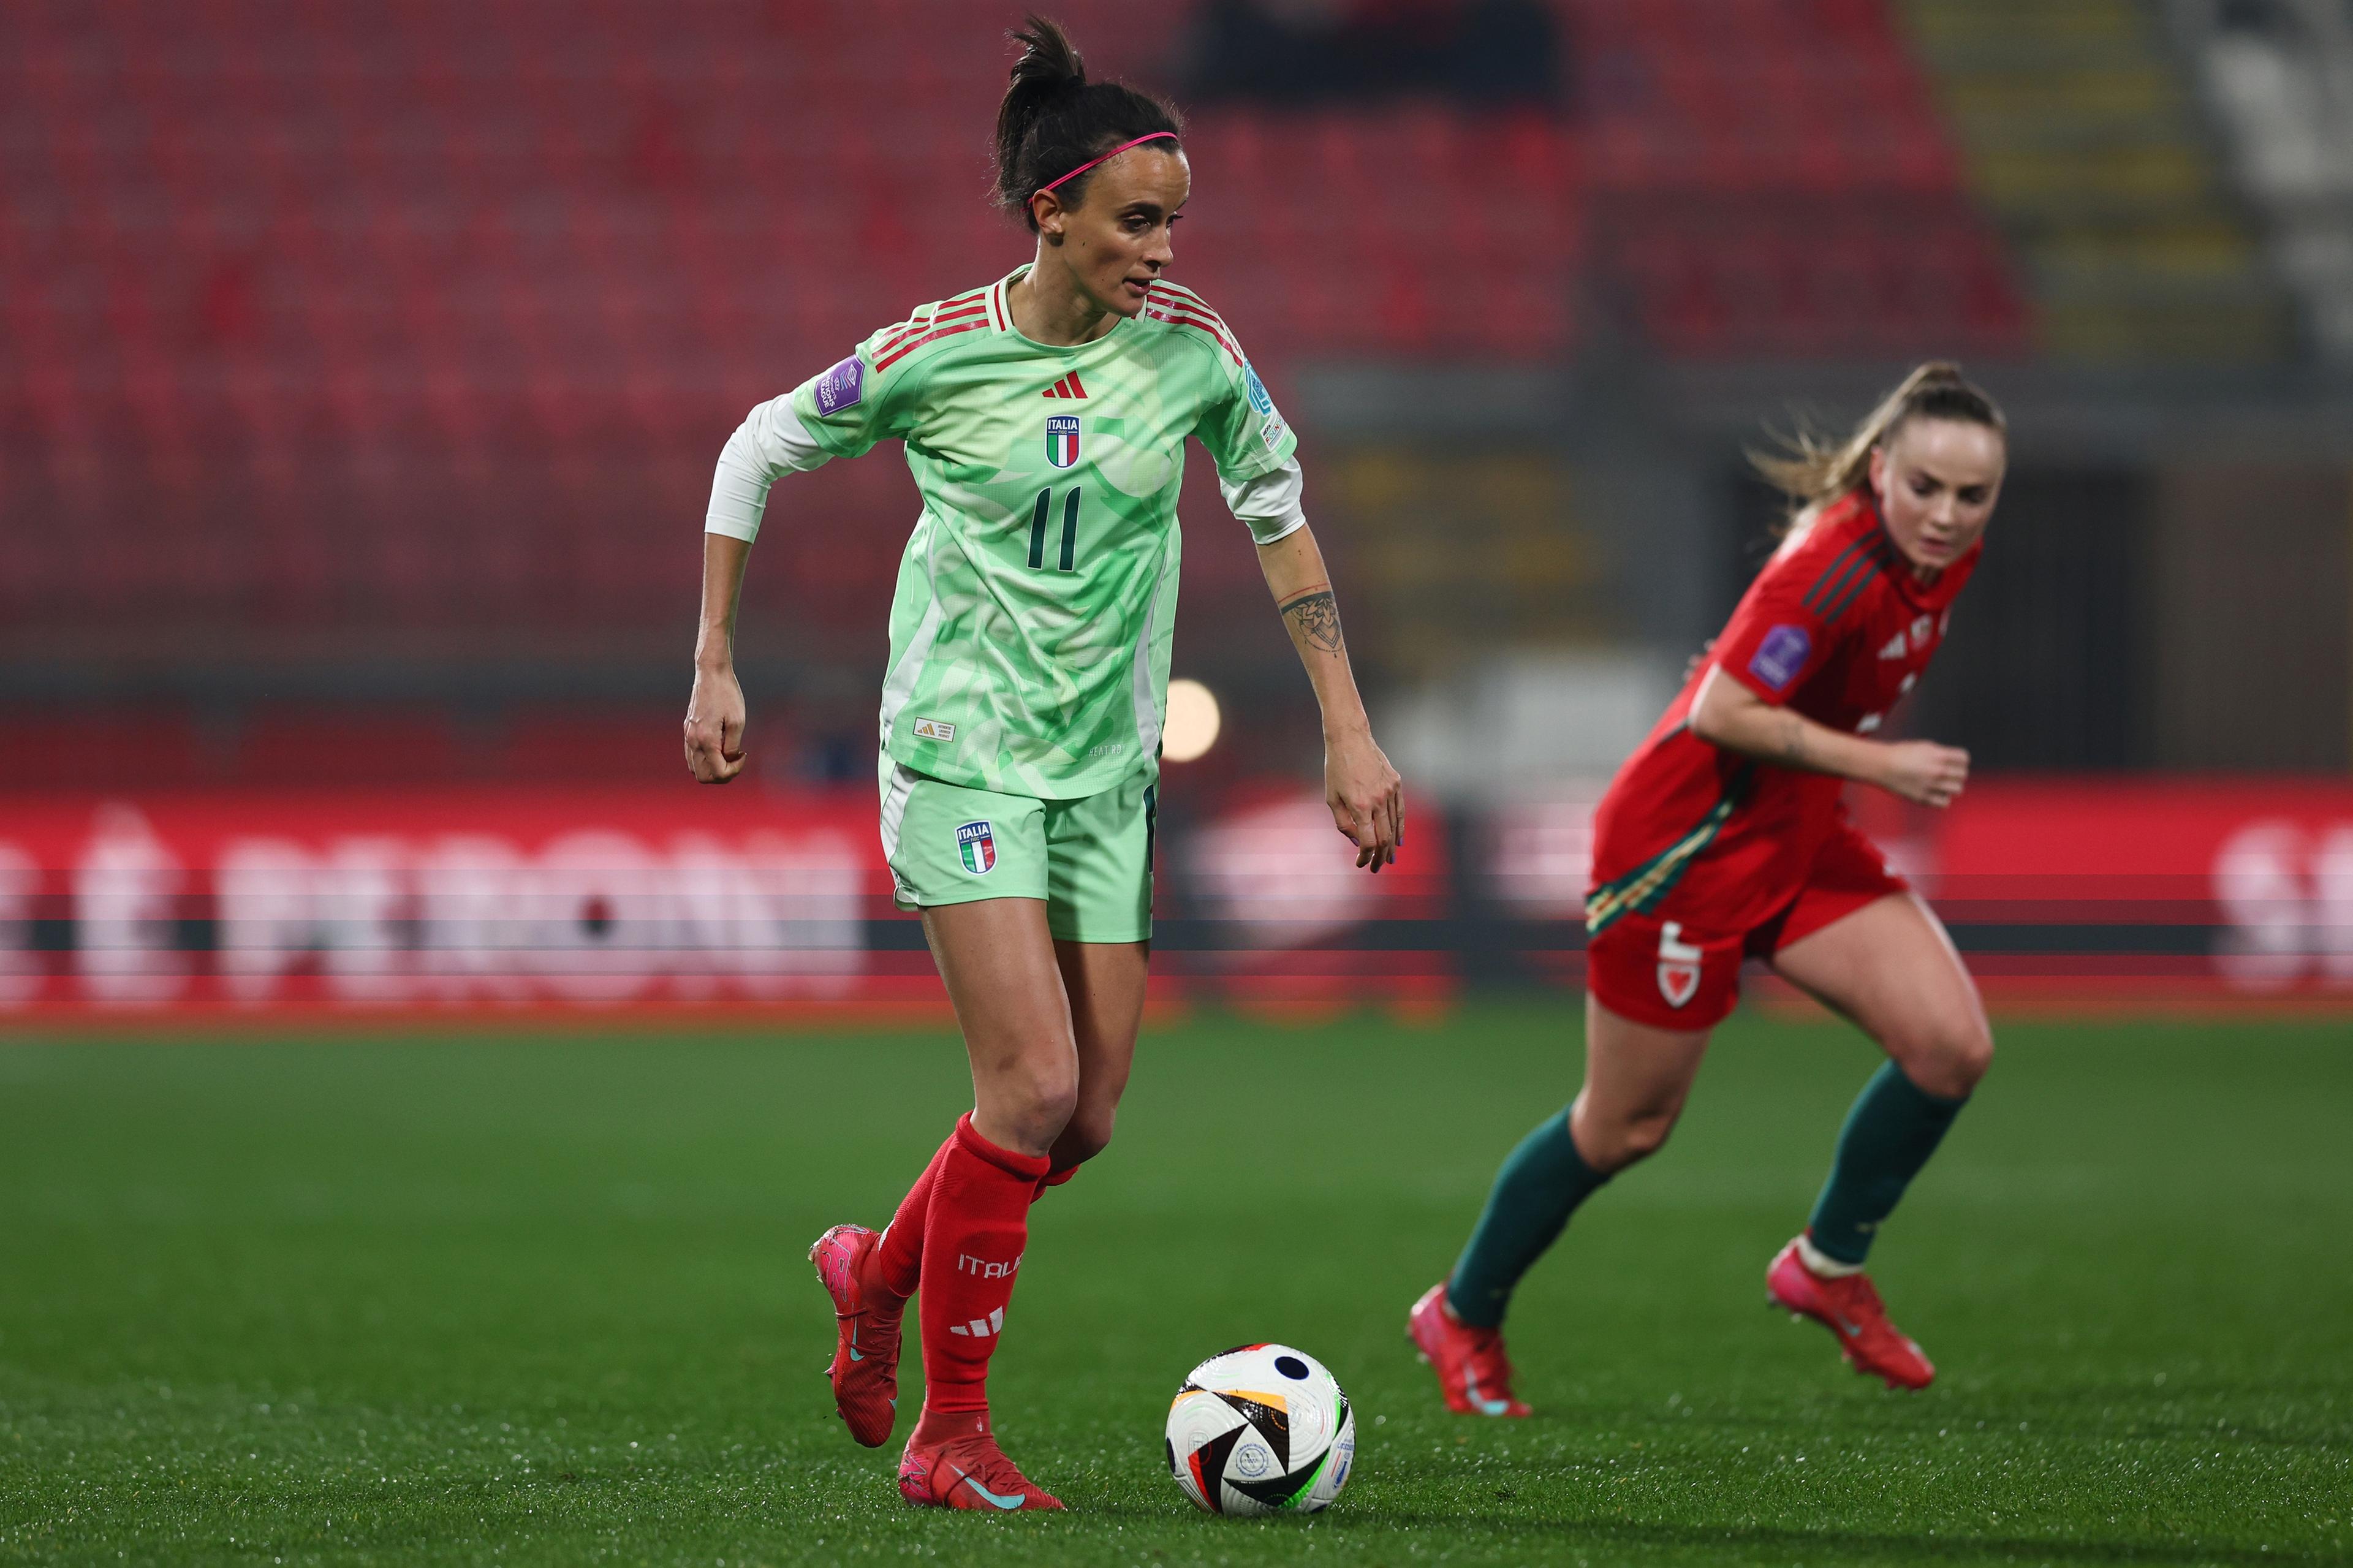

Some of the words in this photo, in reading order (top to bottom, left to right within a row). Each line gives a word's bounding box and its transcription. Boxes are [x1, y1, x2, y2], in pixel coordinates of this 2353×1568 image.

[820, 379, 830, 409] LEAGUE
[826, 374, 835, 407] NATIONS
[1048, 419, 1078, 430] ITALIA
[1027, 485, 1082, 572] 11
[958, 824, 990, 841] ITALIA
